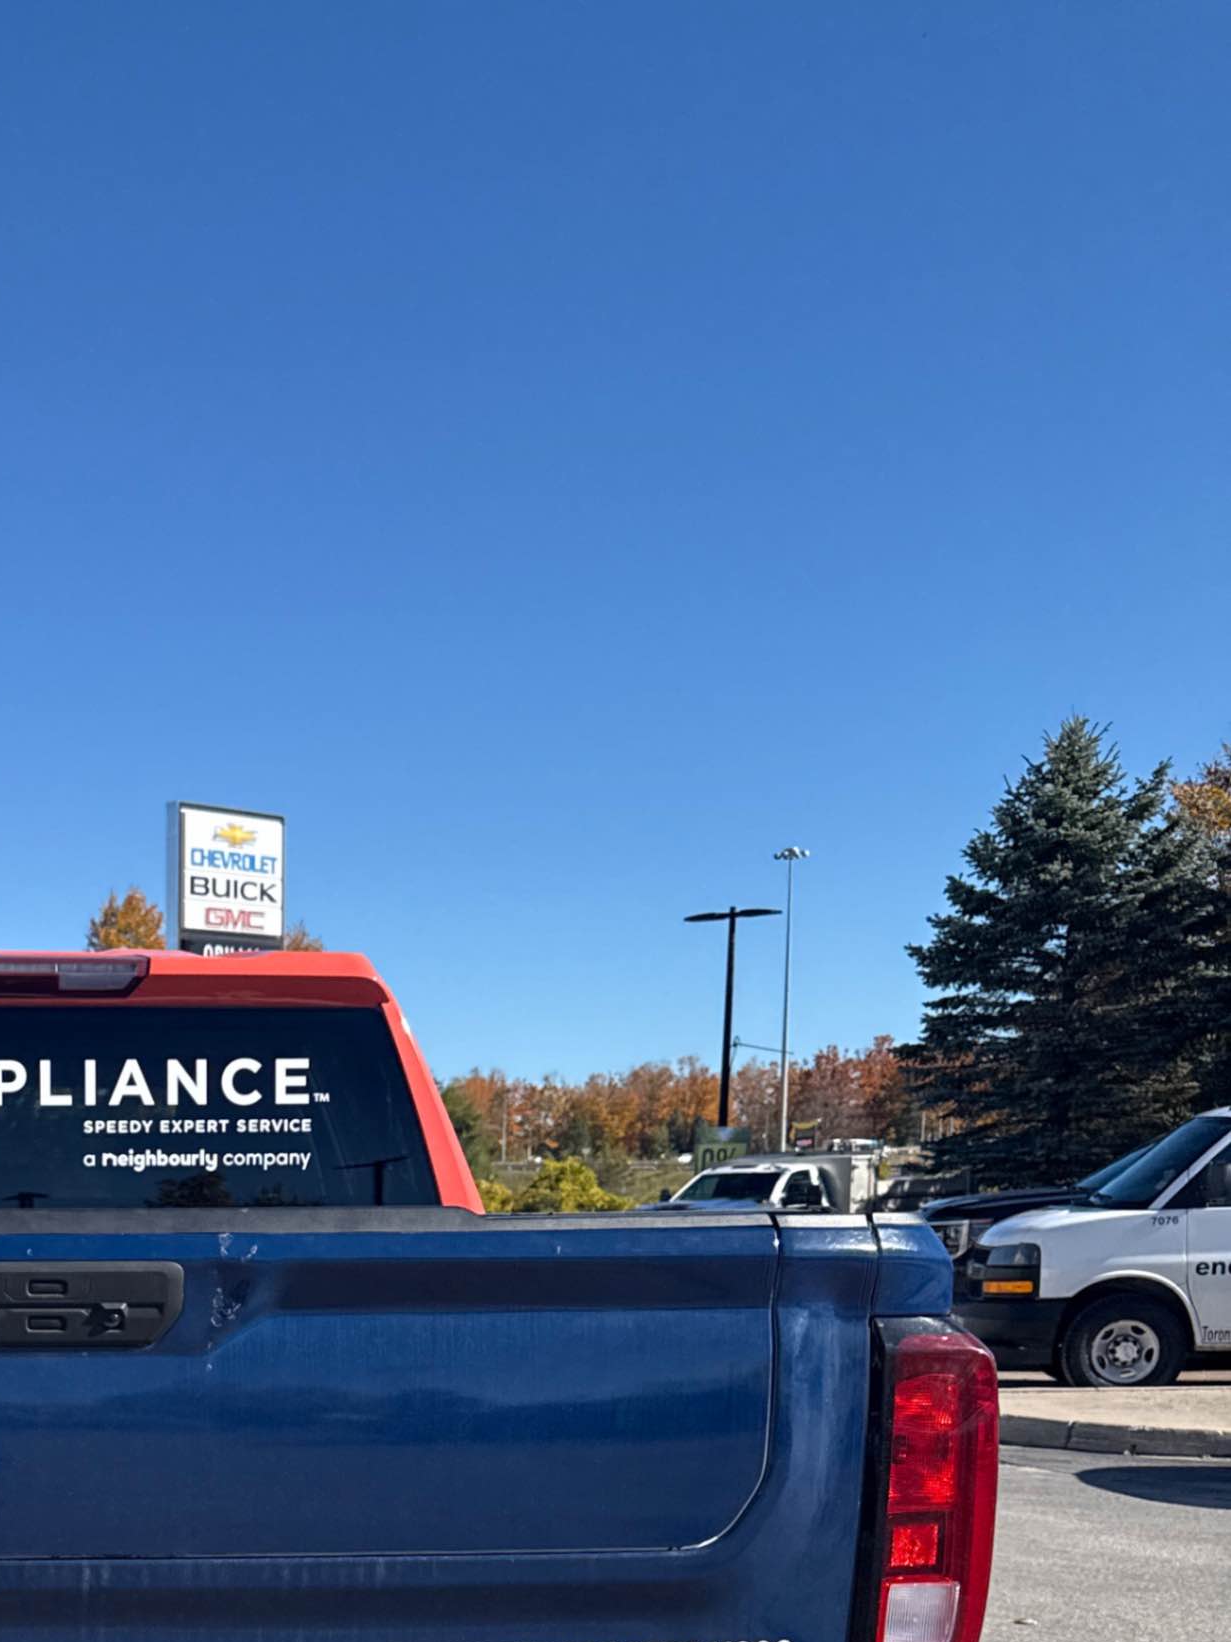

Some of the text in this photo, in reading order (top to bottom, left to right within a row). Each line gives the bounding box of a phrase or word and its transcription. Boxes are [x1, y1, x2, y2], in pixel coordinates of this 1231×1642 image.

[190, 848, 277, 874] CHEVROLET
[190, 875, 277, 903] BUICK
[205, 906, 265, 931] GMC
[83, 1118, 312, 1134] SPEEDY EXPERT SERVICE
[83, 1148, 312, 1173] a neighbourly company
[1151, 1216, 1179, 1226] 7076
[1195, 1260, 1231, 1276] en
